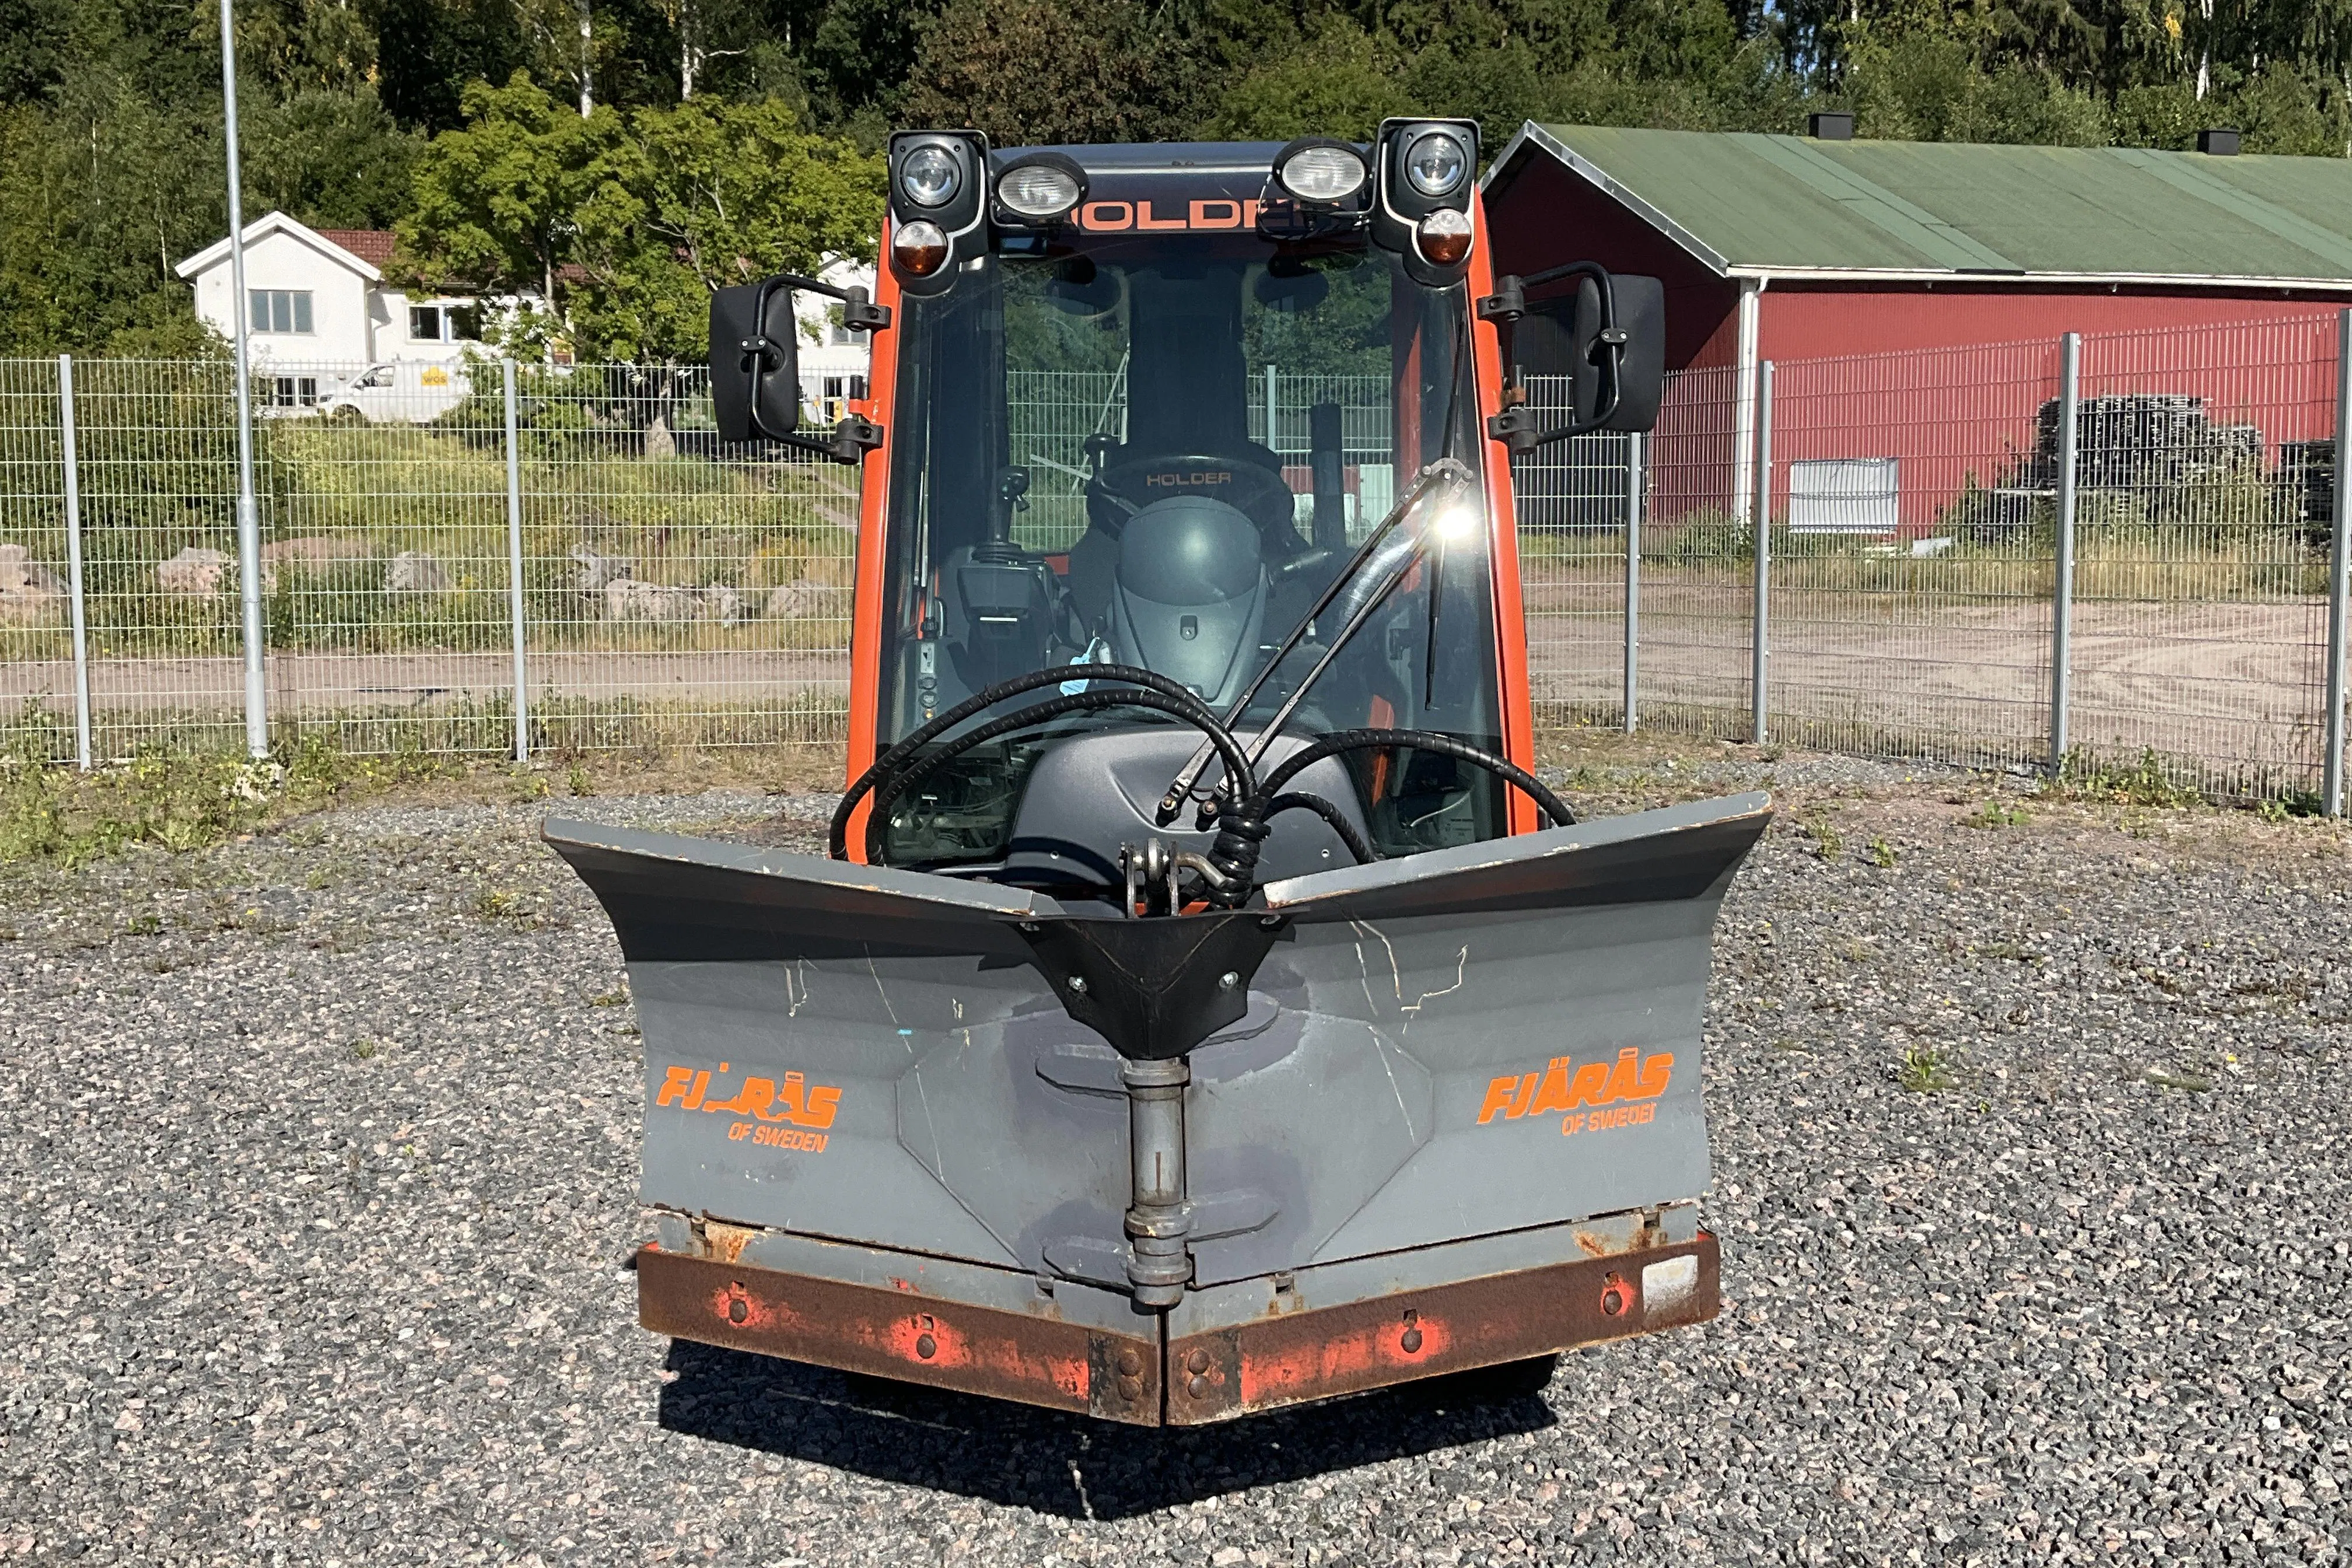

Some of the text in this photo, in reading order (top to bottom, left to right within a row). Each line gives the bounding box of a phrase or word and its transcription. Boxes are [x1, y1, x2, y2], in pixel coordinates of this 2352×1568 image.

[1146, 472, 1232, 487] HOLDER
[1476, 1046, 1675, 1125] FJÄRÅS
[728, 1122, 829, 1153] OF SWEDEN
[1562, 1112, 1586, 1136] OF
